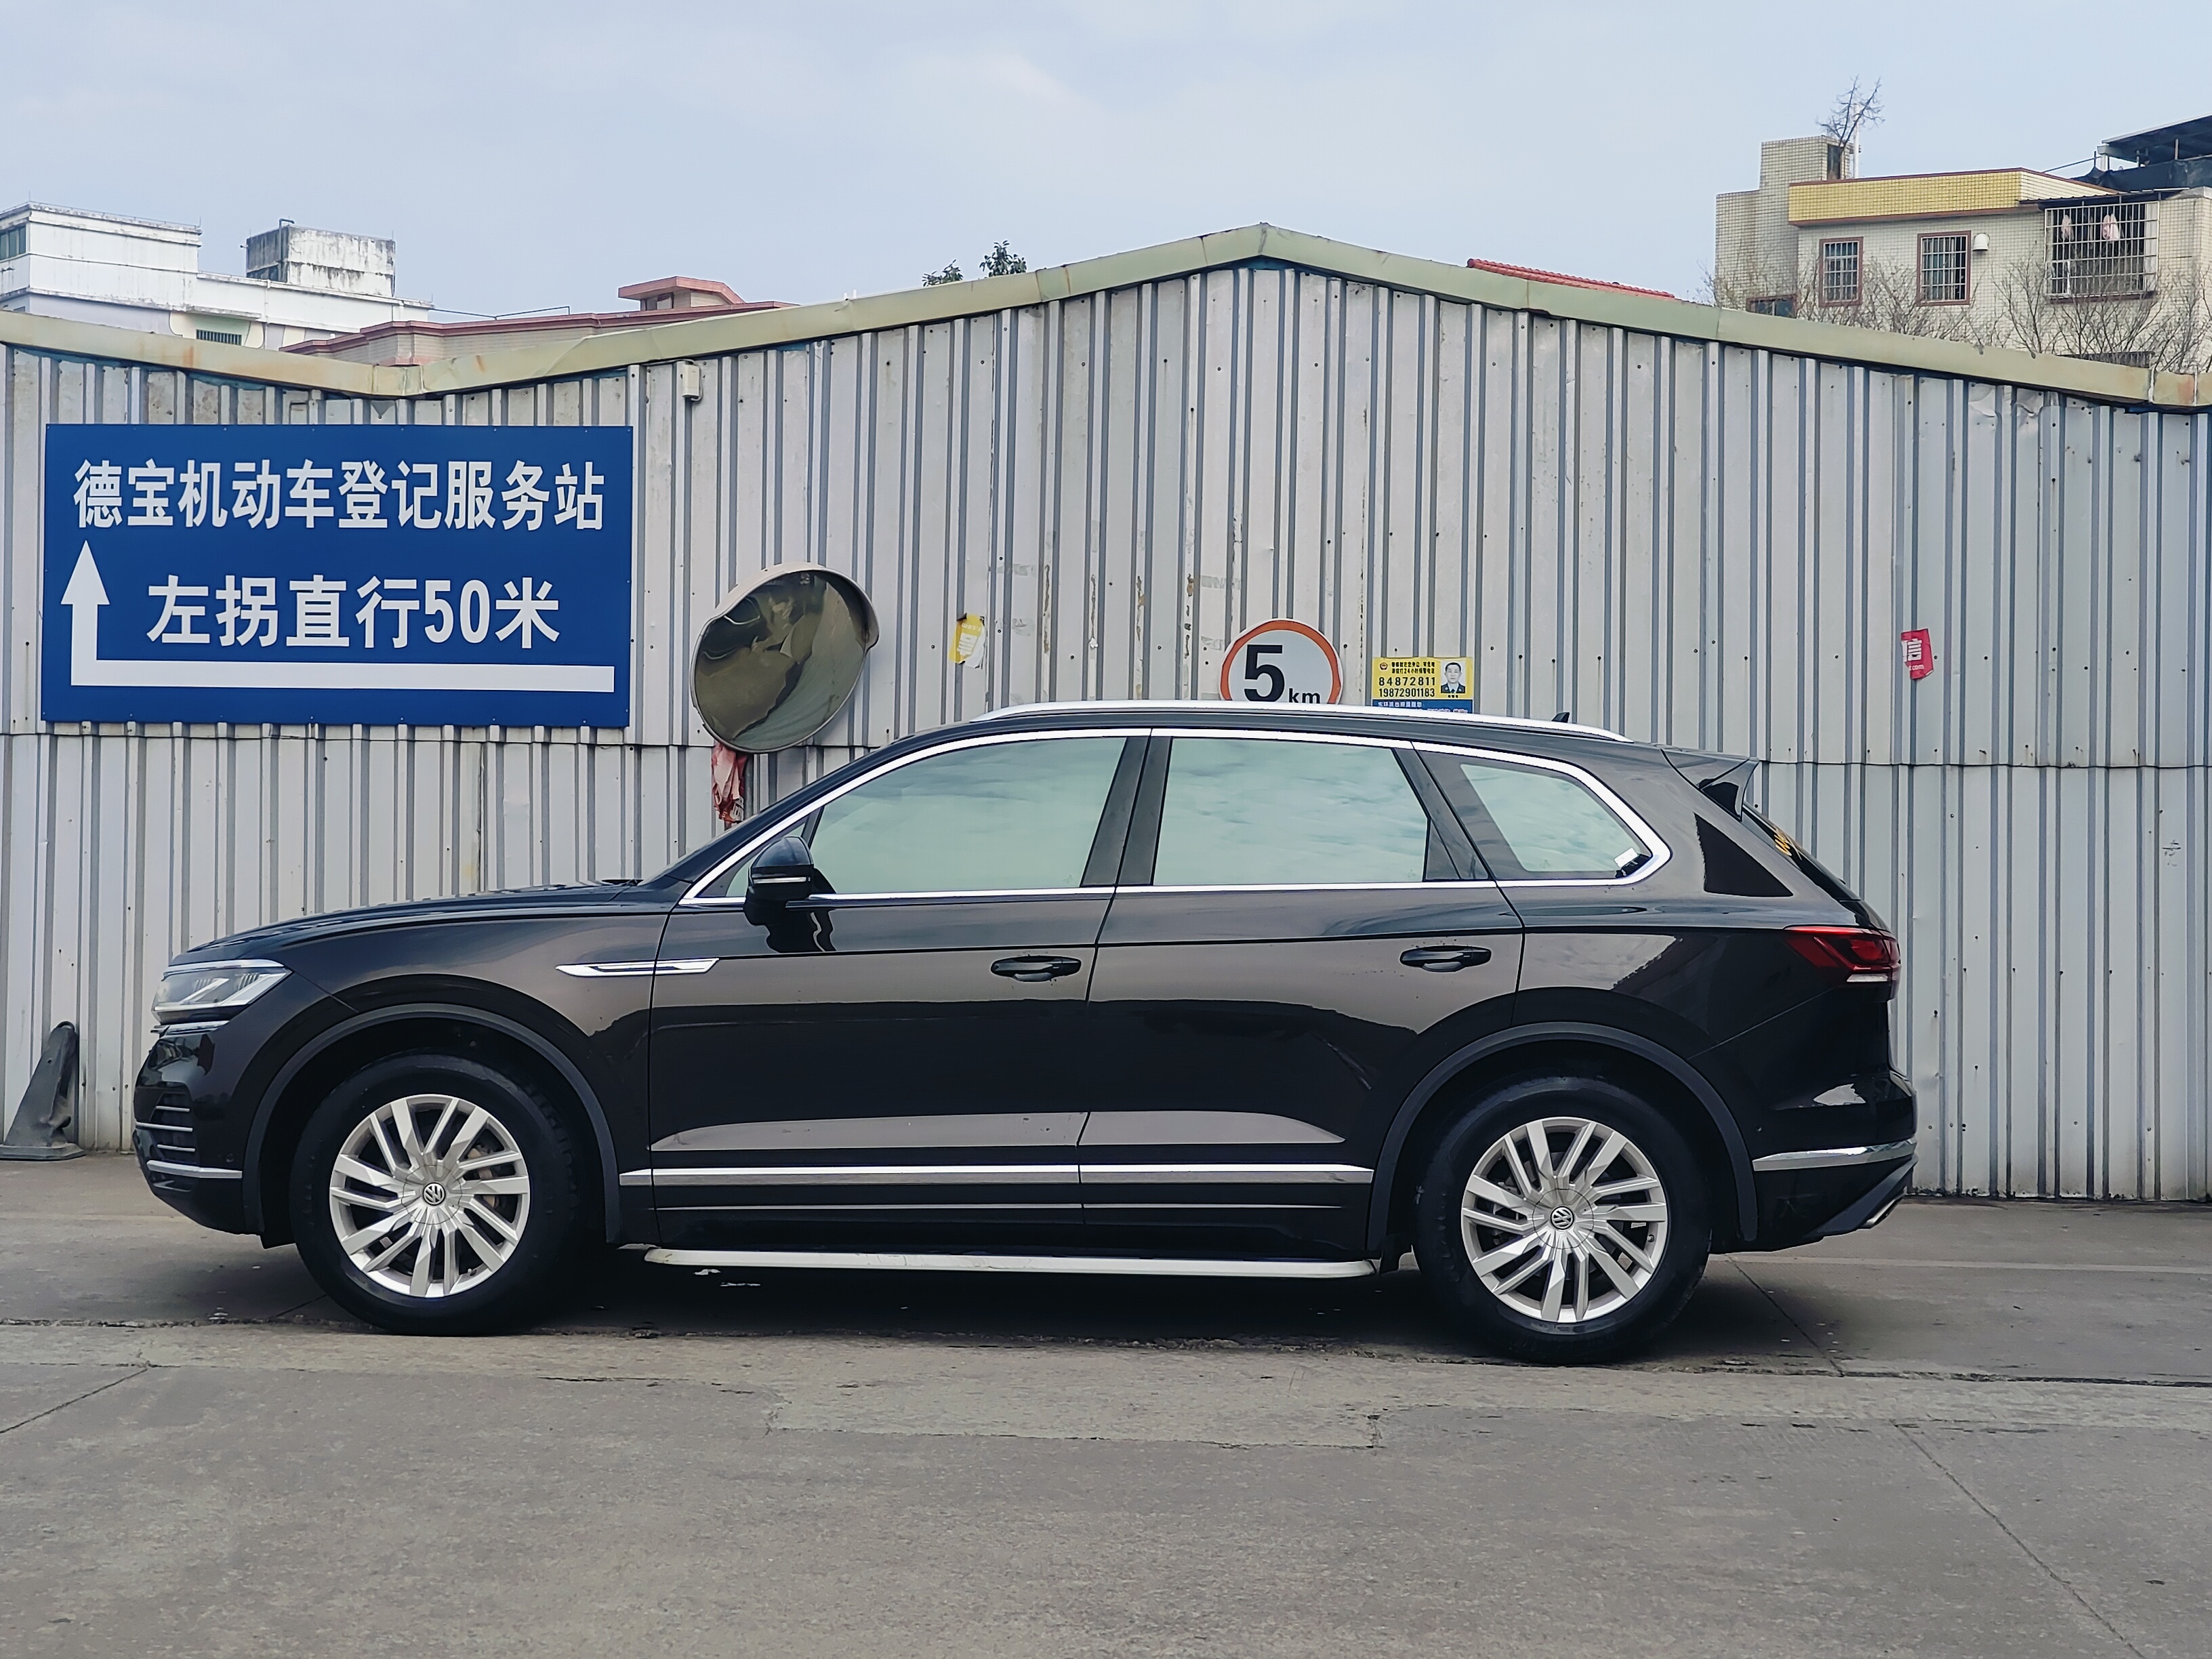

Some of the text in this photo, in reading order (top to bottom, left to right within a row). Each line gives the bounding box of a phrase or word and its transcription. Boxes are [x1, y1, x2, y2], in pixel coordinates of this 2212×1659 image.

[74, 459, 605, 531] 德宝机动车登记服务站
[146, 575, 560, 650] 左拐直行50米
[1244, 644, 1320, 704] 5 km
[1378, 676, 1435, 686] 84872811
[1378, 688, 1435, 697] 19872901183
